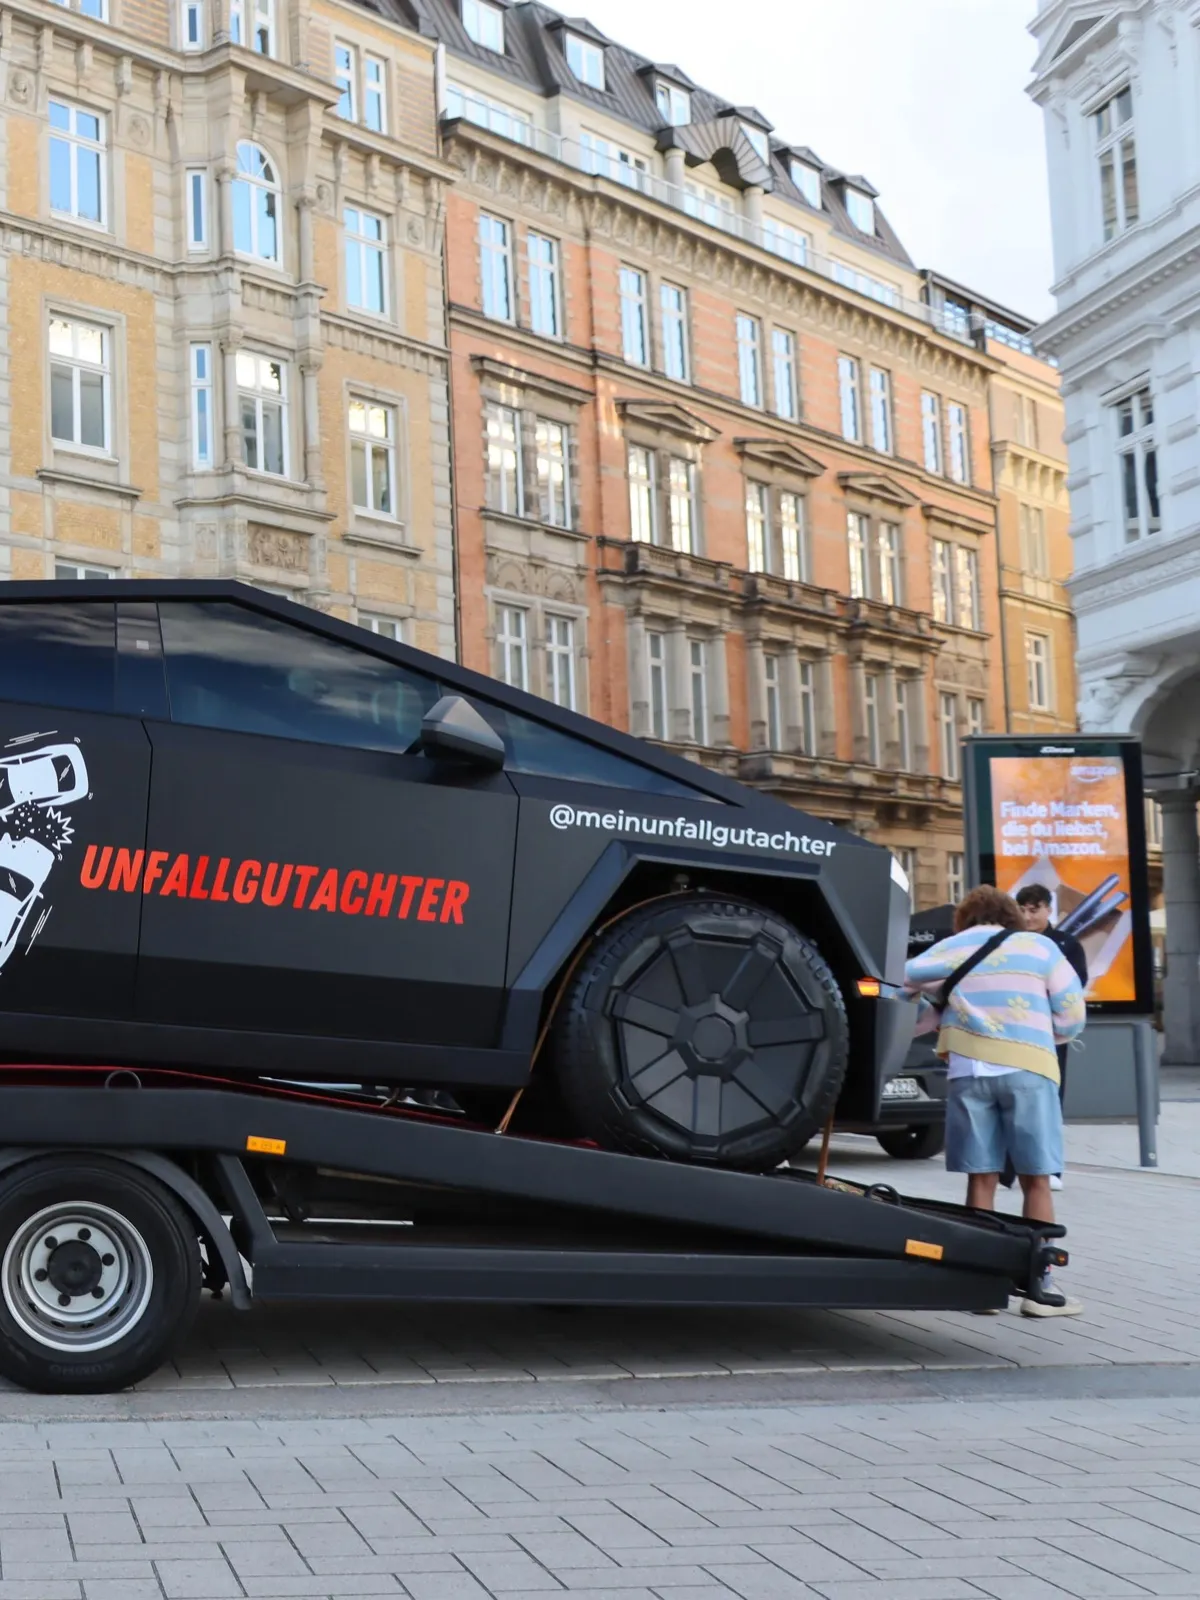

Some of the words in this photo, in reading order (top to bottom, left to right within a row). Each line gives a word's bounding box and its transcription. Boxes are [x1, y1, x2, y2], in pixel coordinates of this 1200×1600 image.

[1000, 801, 1047, 817] Finde
[1050, 801, 1119, 819] Marken,
[549, 803, 837, 857] @meinunfallgutachter
[1002, 821, 1028, 837] die
[1031, 821, 1052, 837] du
[1002, 840, 1028, 856] bei
[1031, 840, 1106, 856] Amazon.
[79, 843, 471, 925] UNFALLGUTACHTER
